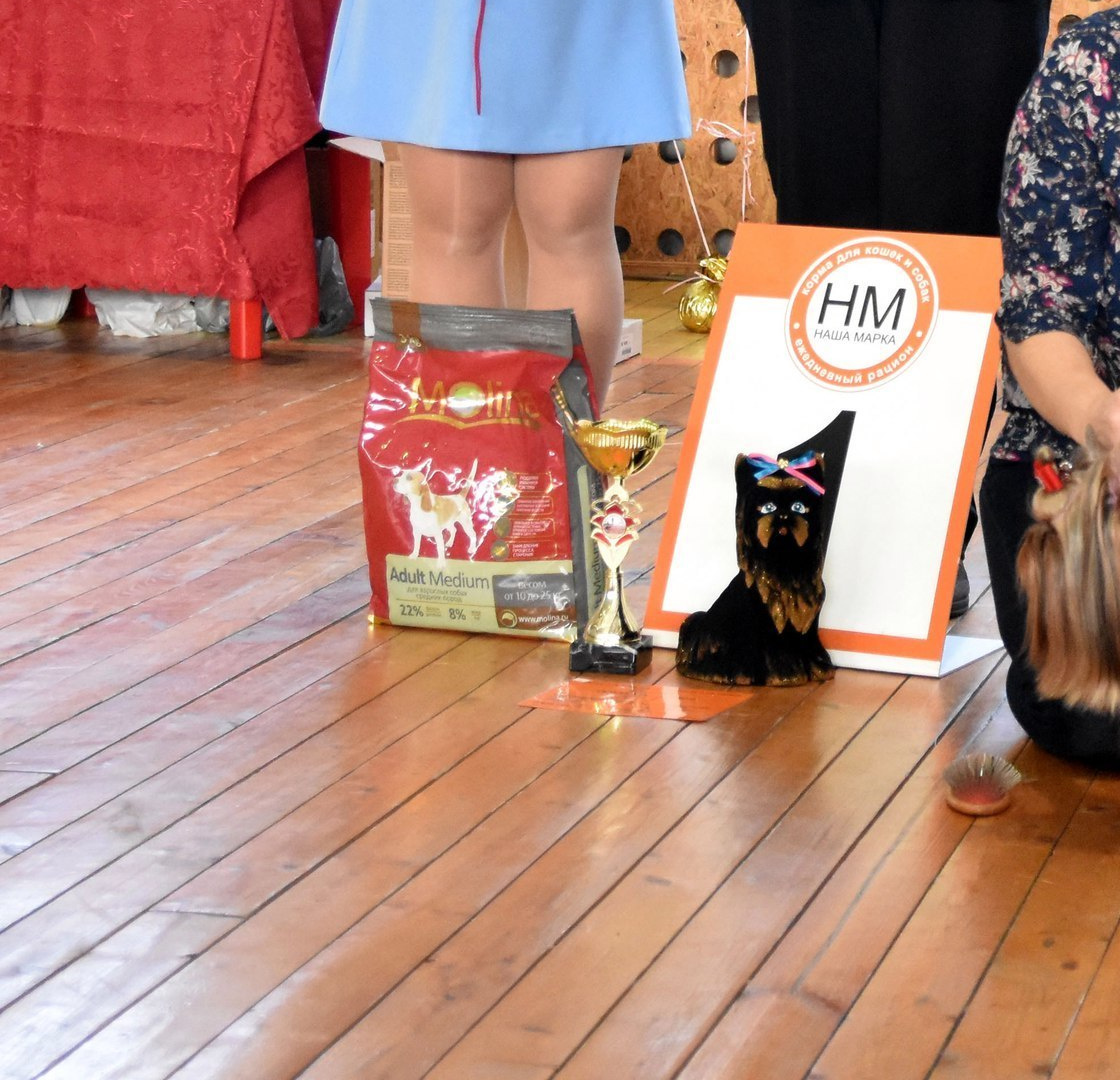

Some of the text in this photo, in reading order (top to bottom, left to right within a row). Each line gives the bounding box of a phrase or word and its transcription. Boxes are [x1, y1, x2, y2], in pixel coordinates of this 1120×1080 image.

[801, 246, 931, 304] корма для кошек и собак
[817, 282, 907, 331] НМ
[813, 329, 896, 345] НАША МАРКА
[794, 337, 914, 384] ежедневный рацион
[777, 409, 857, 586] 1
[390, 566, 490, 590] Adult Medium
[399, 604, 424, 618] 22%
[448, 607, 467, 621] 8%
[516, 591, 526, 601] 10
